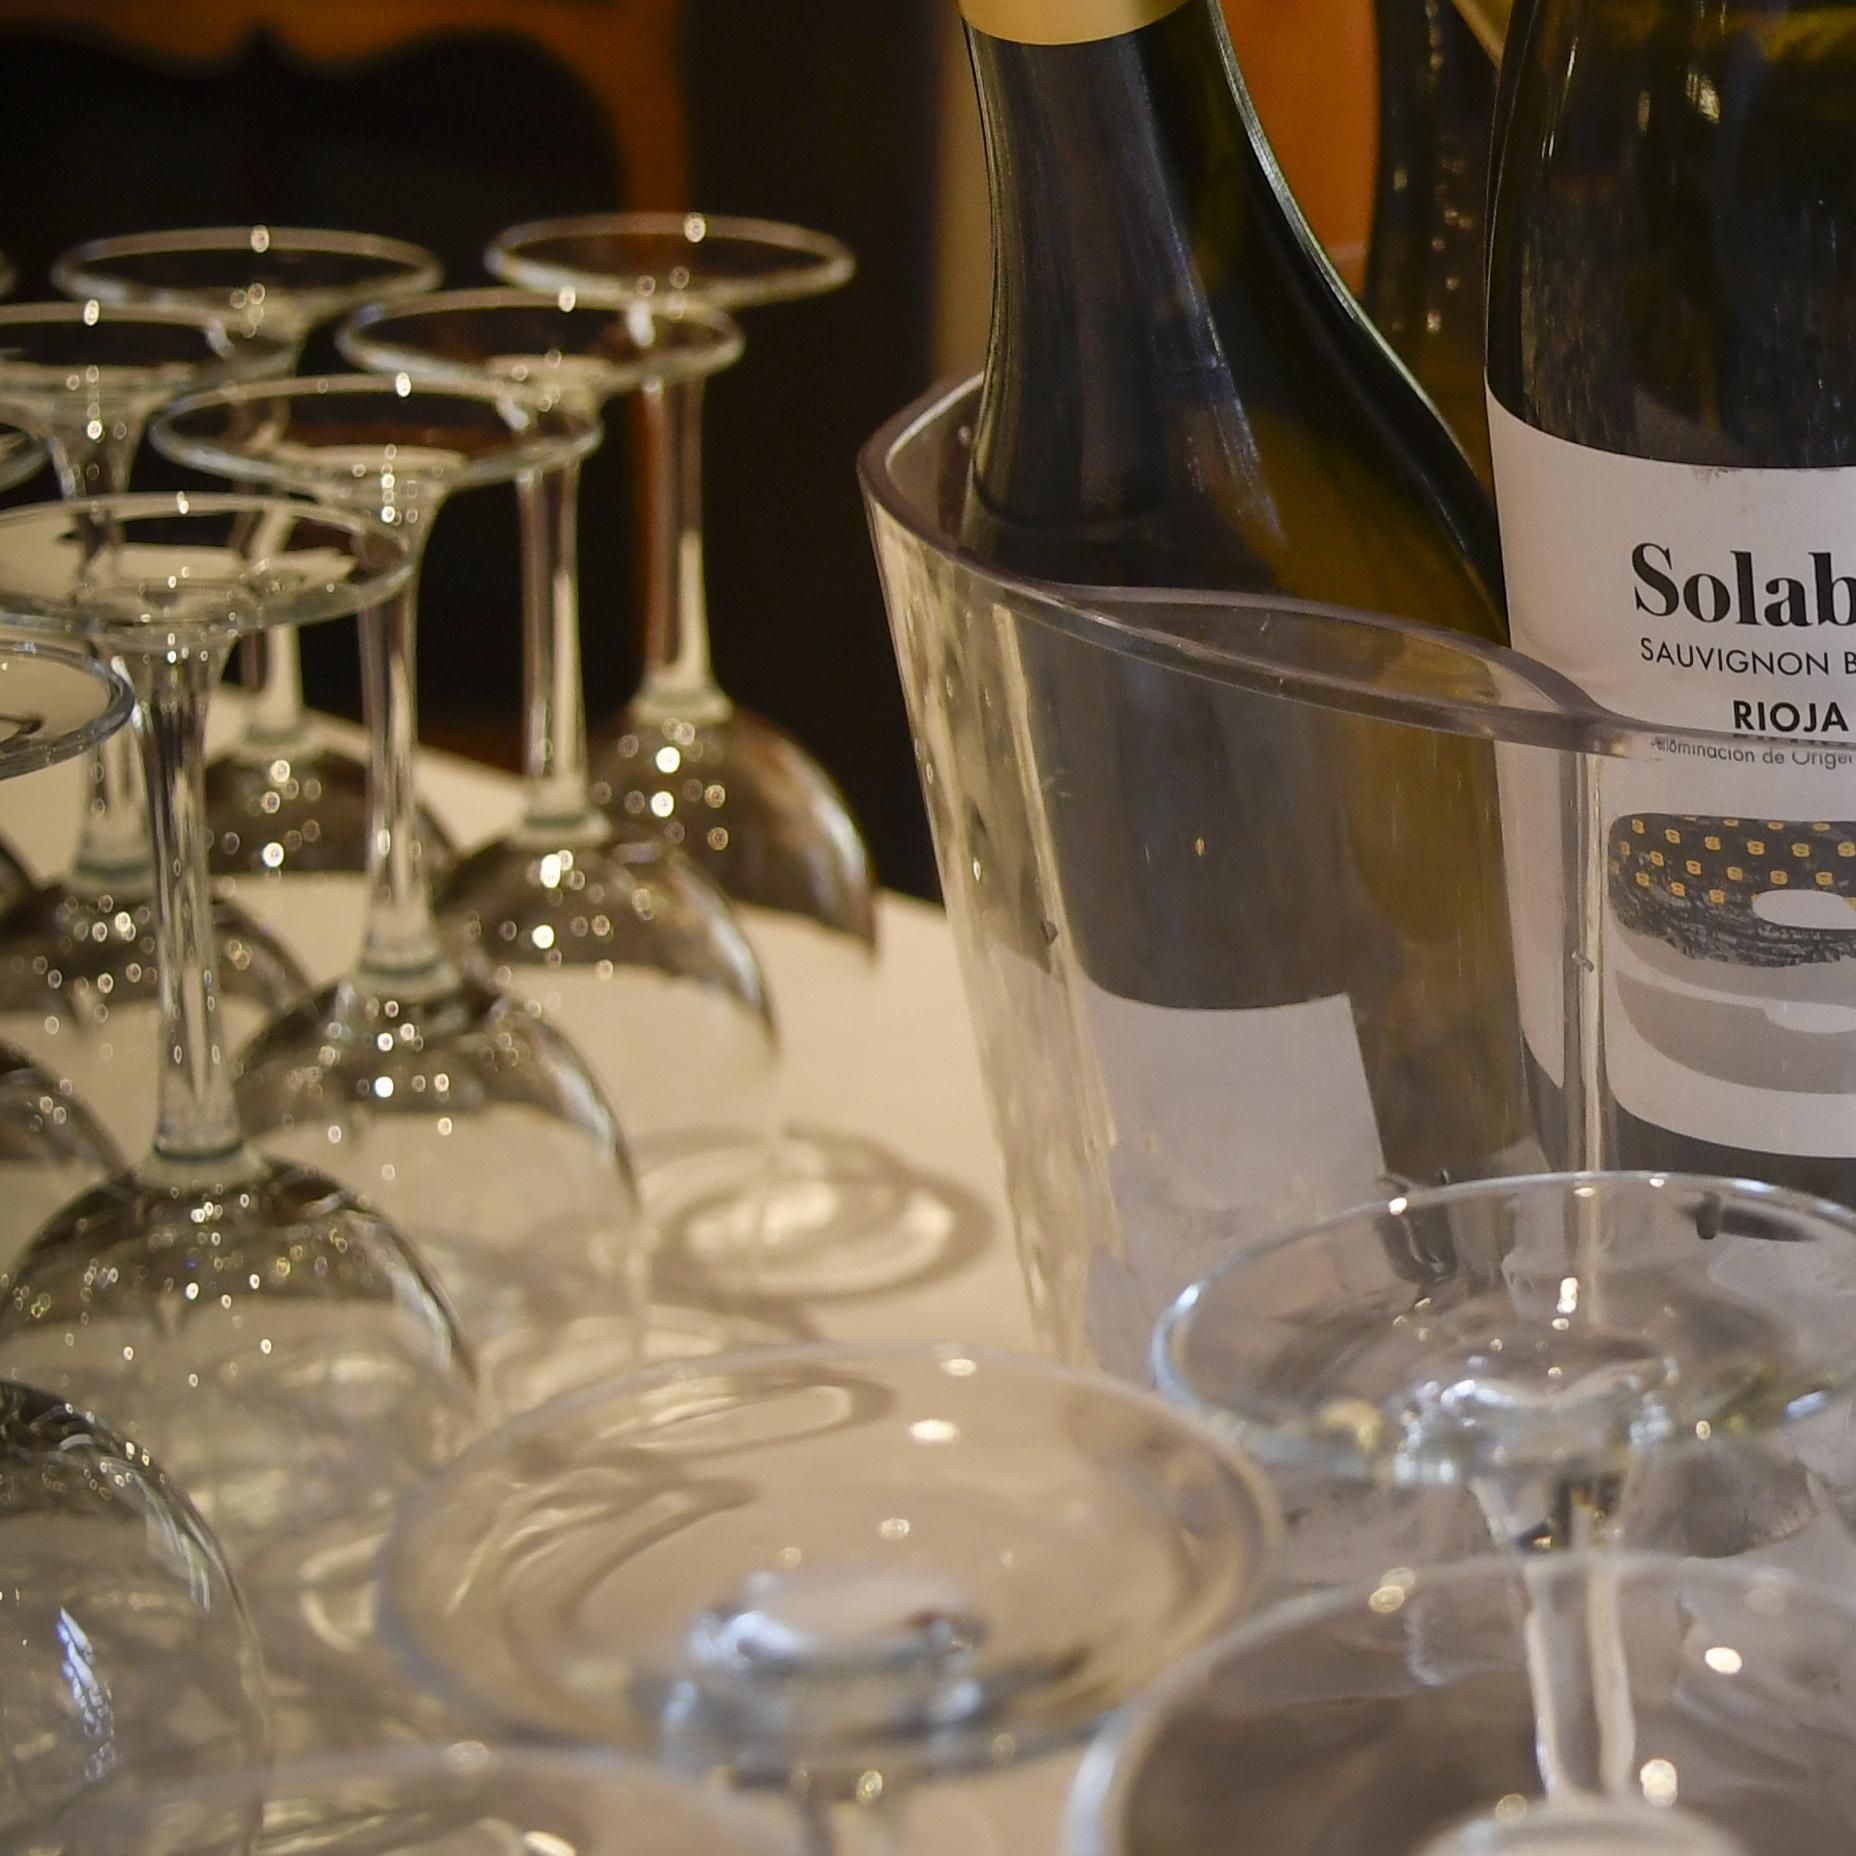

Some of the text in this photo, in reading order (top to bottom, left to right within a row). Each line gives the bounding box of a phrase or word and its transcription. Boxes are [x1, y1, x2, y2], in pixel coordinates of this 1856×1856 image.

[1639, 636, 1830, 677] SAUVIGNON
[1732, 699, 1849, 733] RIOJA
[1762, 748, 1785, 765] de
